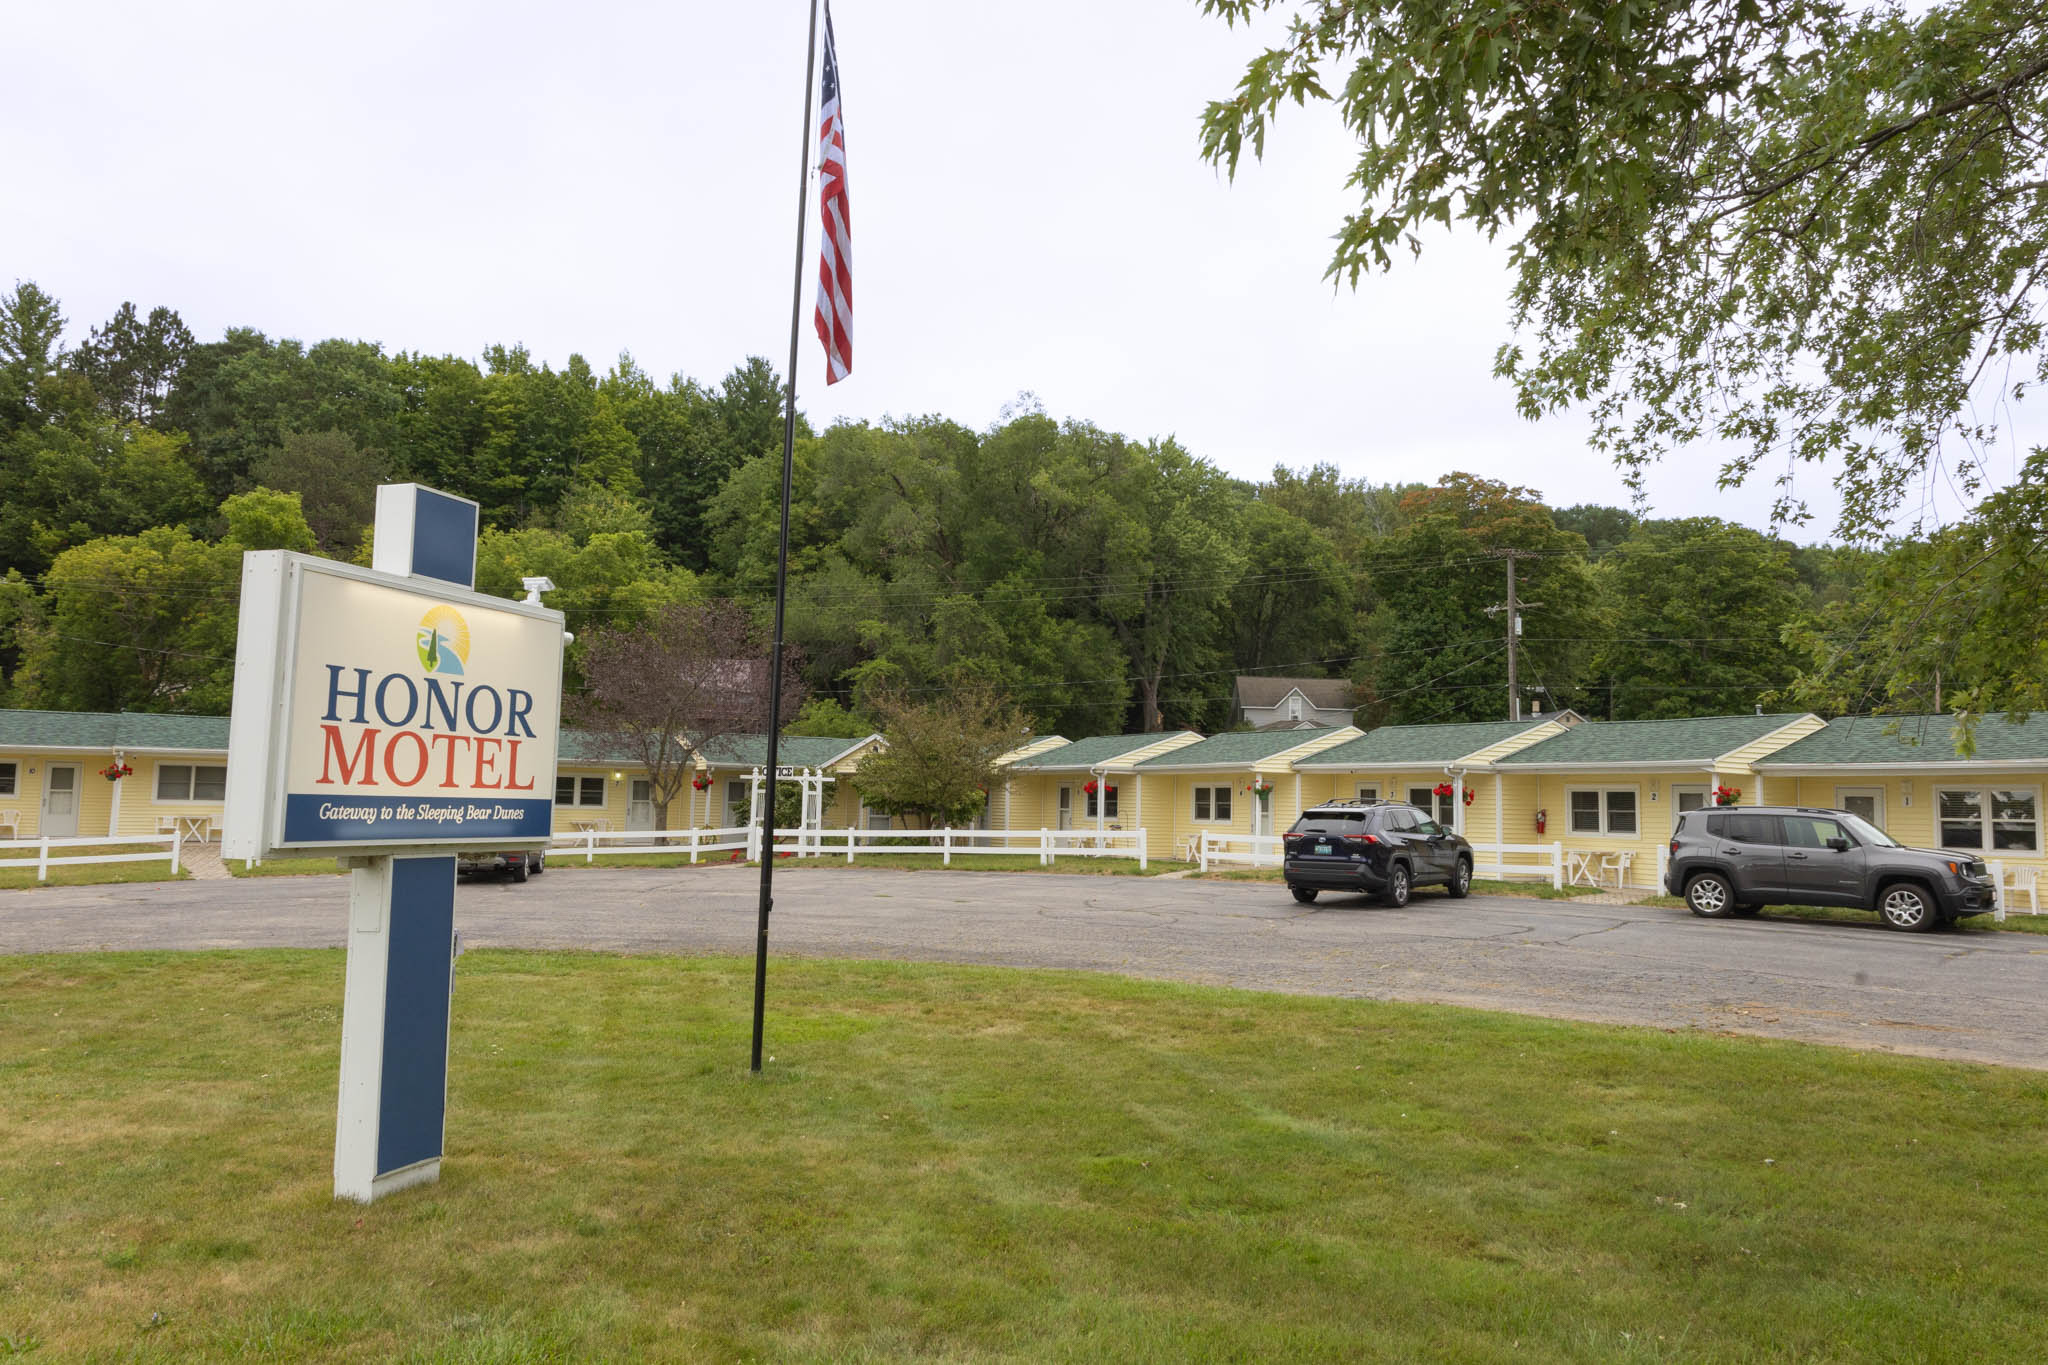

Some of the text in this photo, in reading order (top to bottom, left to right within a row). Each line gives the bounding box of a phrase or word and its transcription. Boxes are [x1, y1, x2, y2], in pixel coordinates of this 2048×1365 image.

[320, 663, 537, 738] HONOR
[315, 724, 535, 791] MOTEL
[762, 766, 793, 777] OICE
[319, 803, 524, 824] Gateway to the Sleeping Bear Dunes
